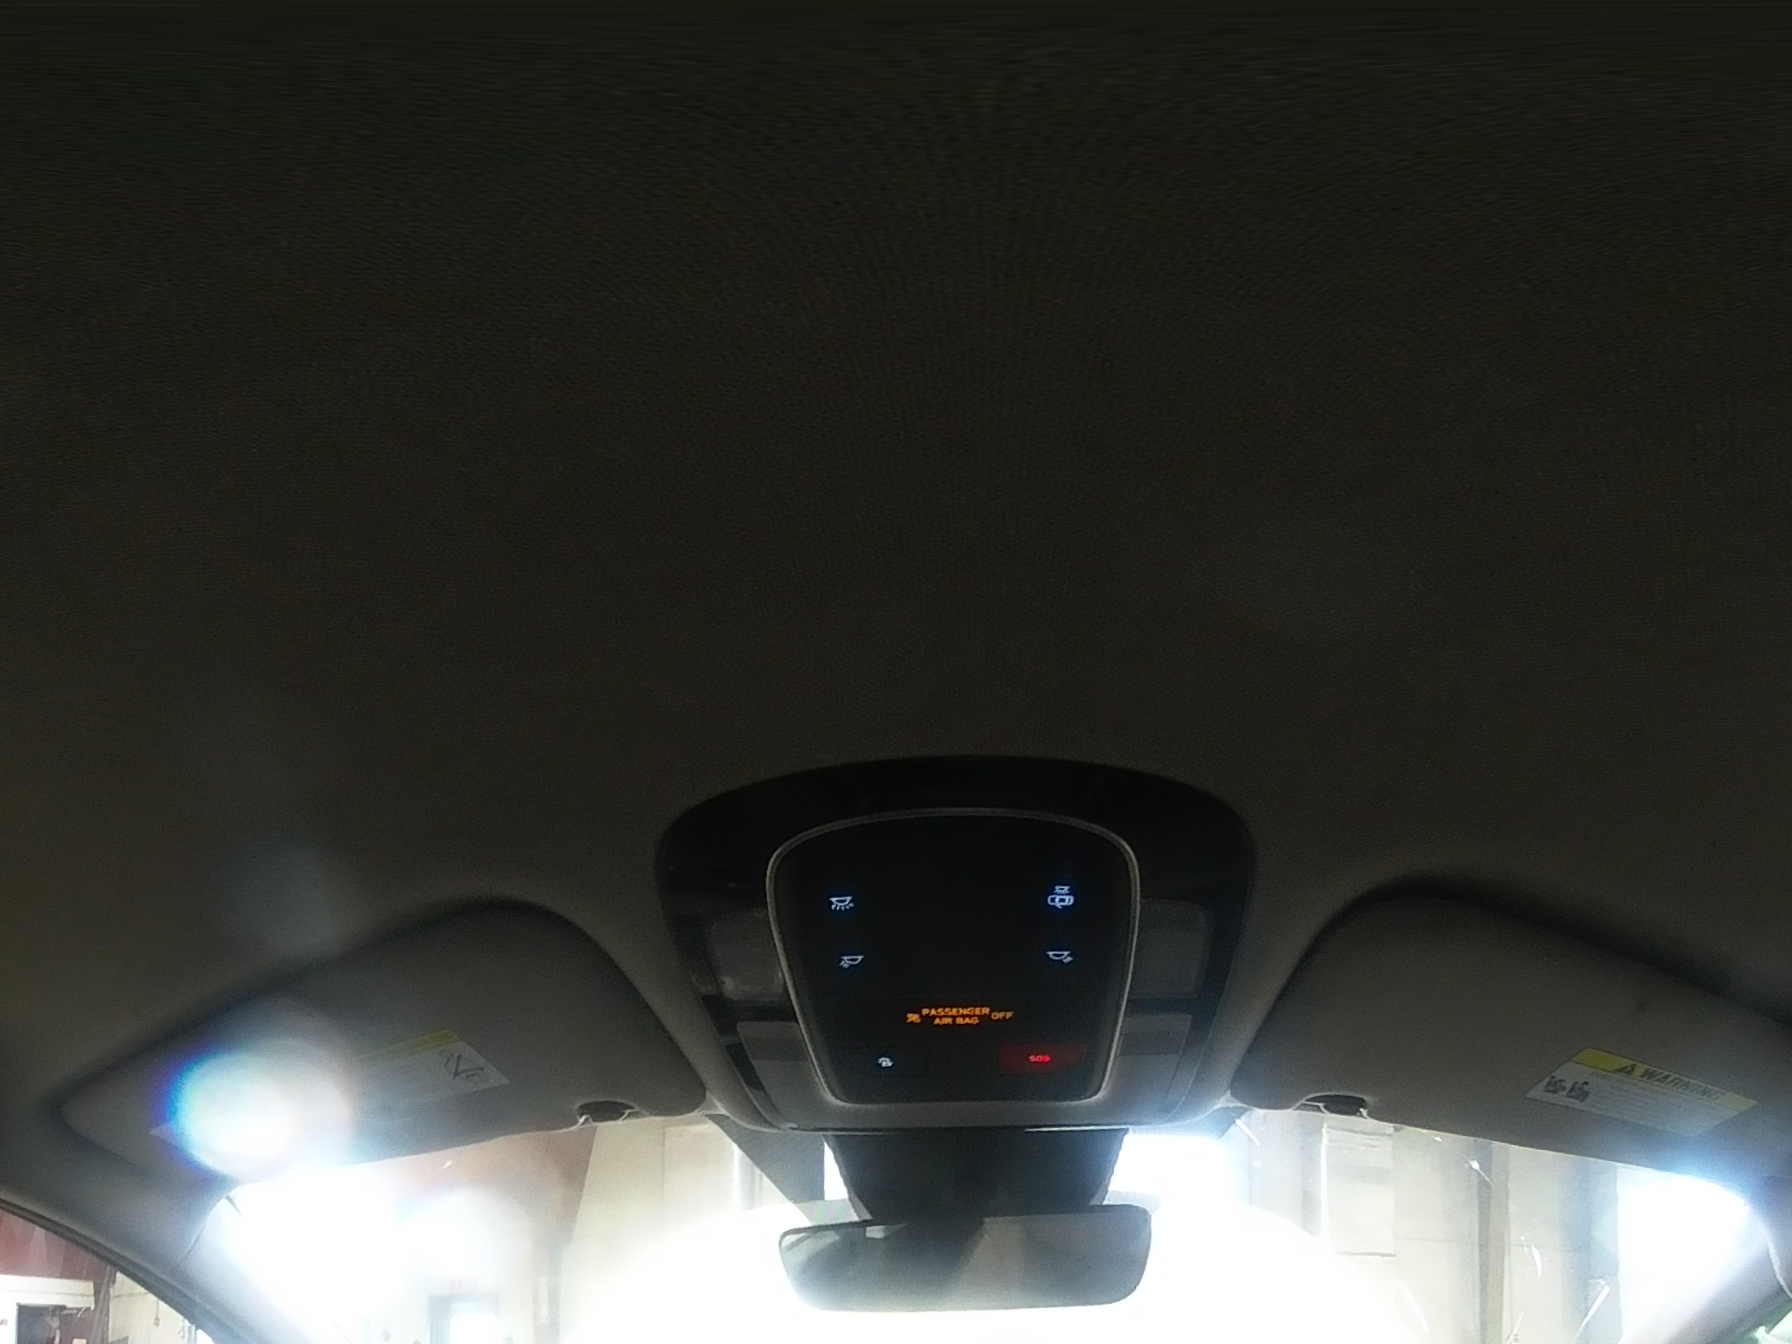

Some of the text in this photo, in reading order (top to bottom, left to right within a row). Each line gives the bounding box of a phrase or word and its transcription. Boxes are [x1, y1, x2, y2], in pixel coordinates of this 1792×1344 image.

[922, 1007, 991, 1017] PASSENGER
[991, 1011, 1014, 1020] OFF
[933, 1017, 979, 1025] AIR BAG
[1028, 1055, 1050, 1063] SOS
[1639, 1067, 1724, 1101] WARNING
